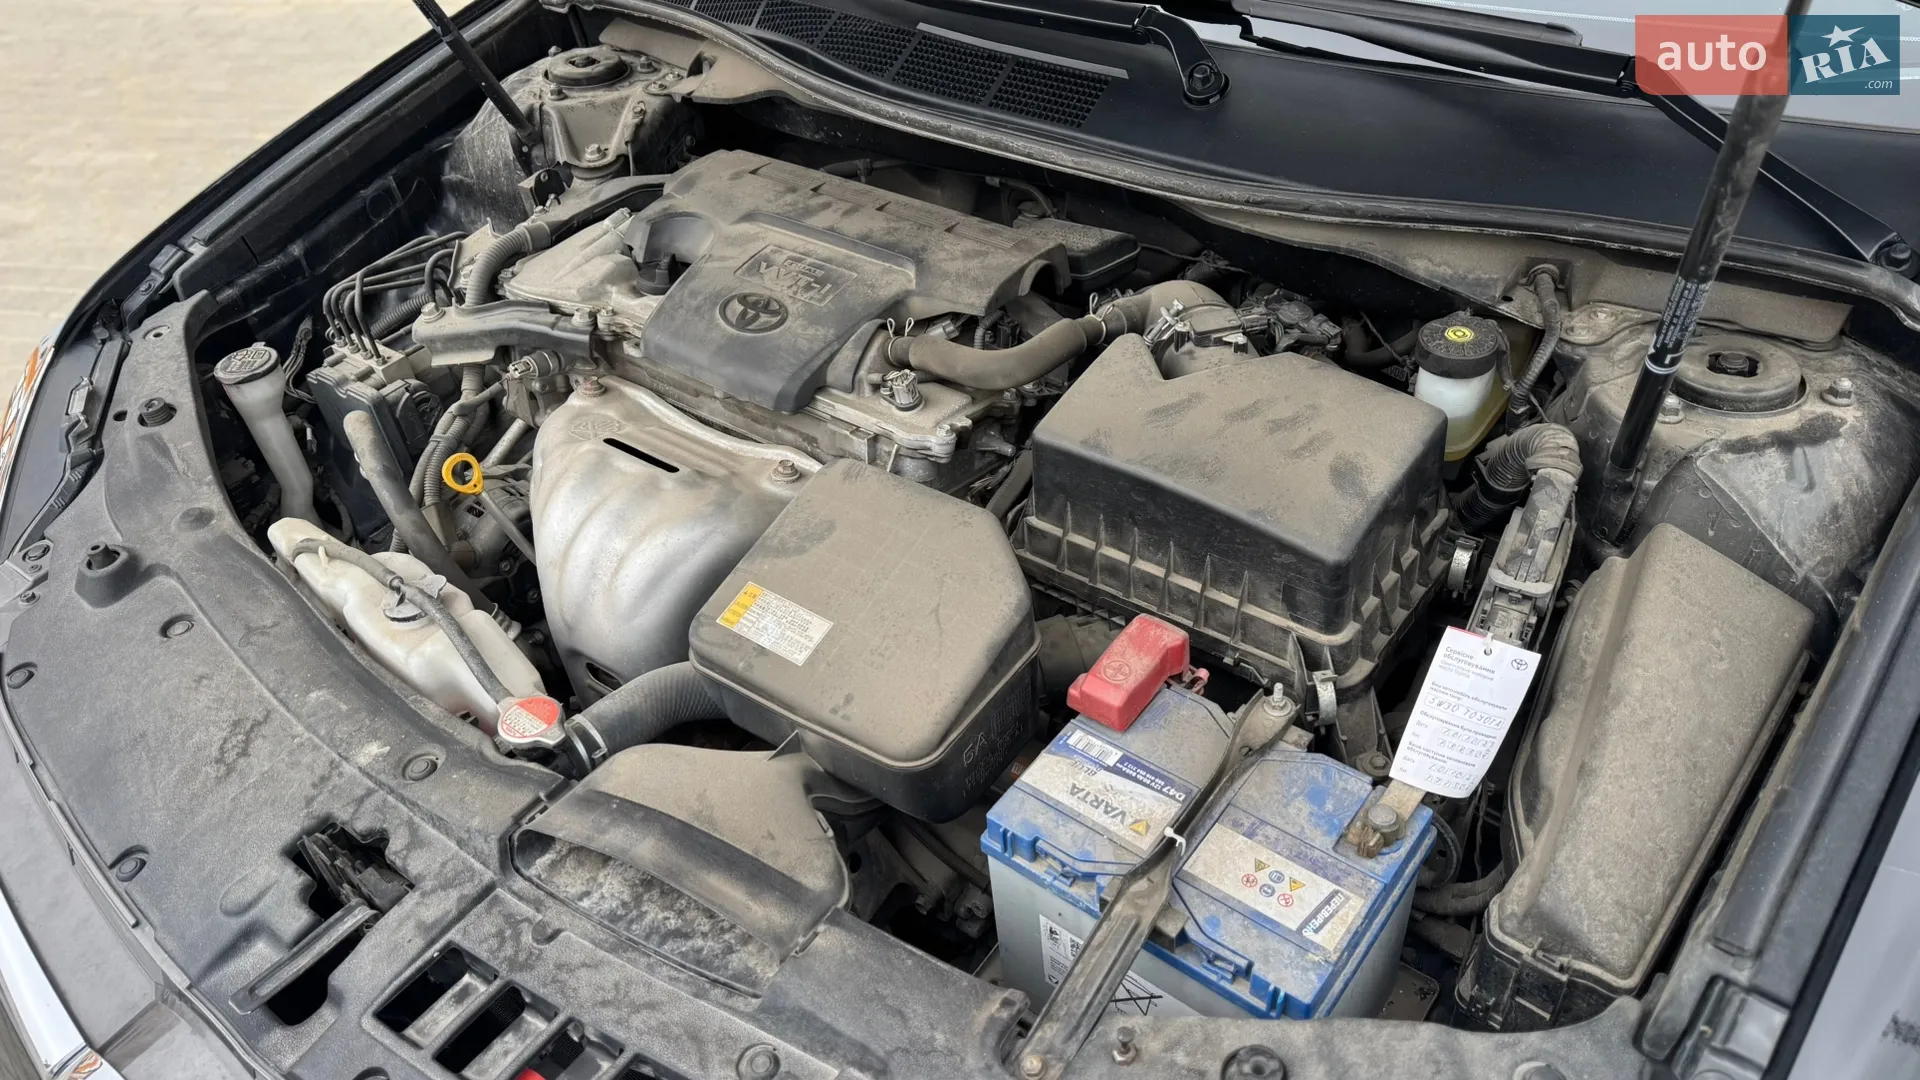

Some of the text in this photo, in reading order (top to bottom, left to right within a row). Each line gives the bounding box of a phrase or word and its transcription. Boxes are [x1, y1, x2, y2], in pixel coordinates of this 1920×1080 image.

[1066, 781, 1130, 825] VARTA
[1161, 782, 1187, 802] D47
[1301, 891, 1345, 936] ПЕРЕВІРЕНО
